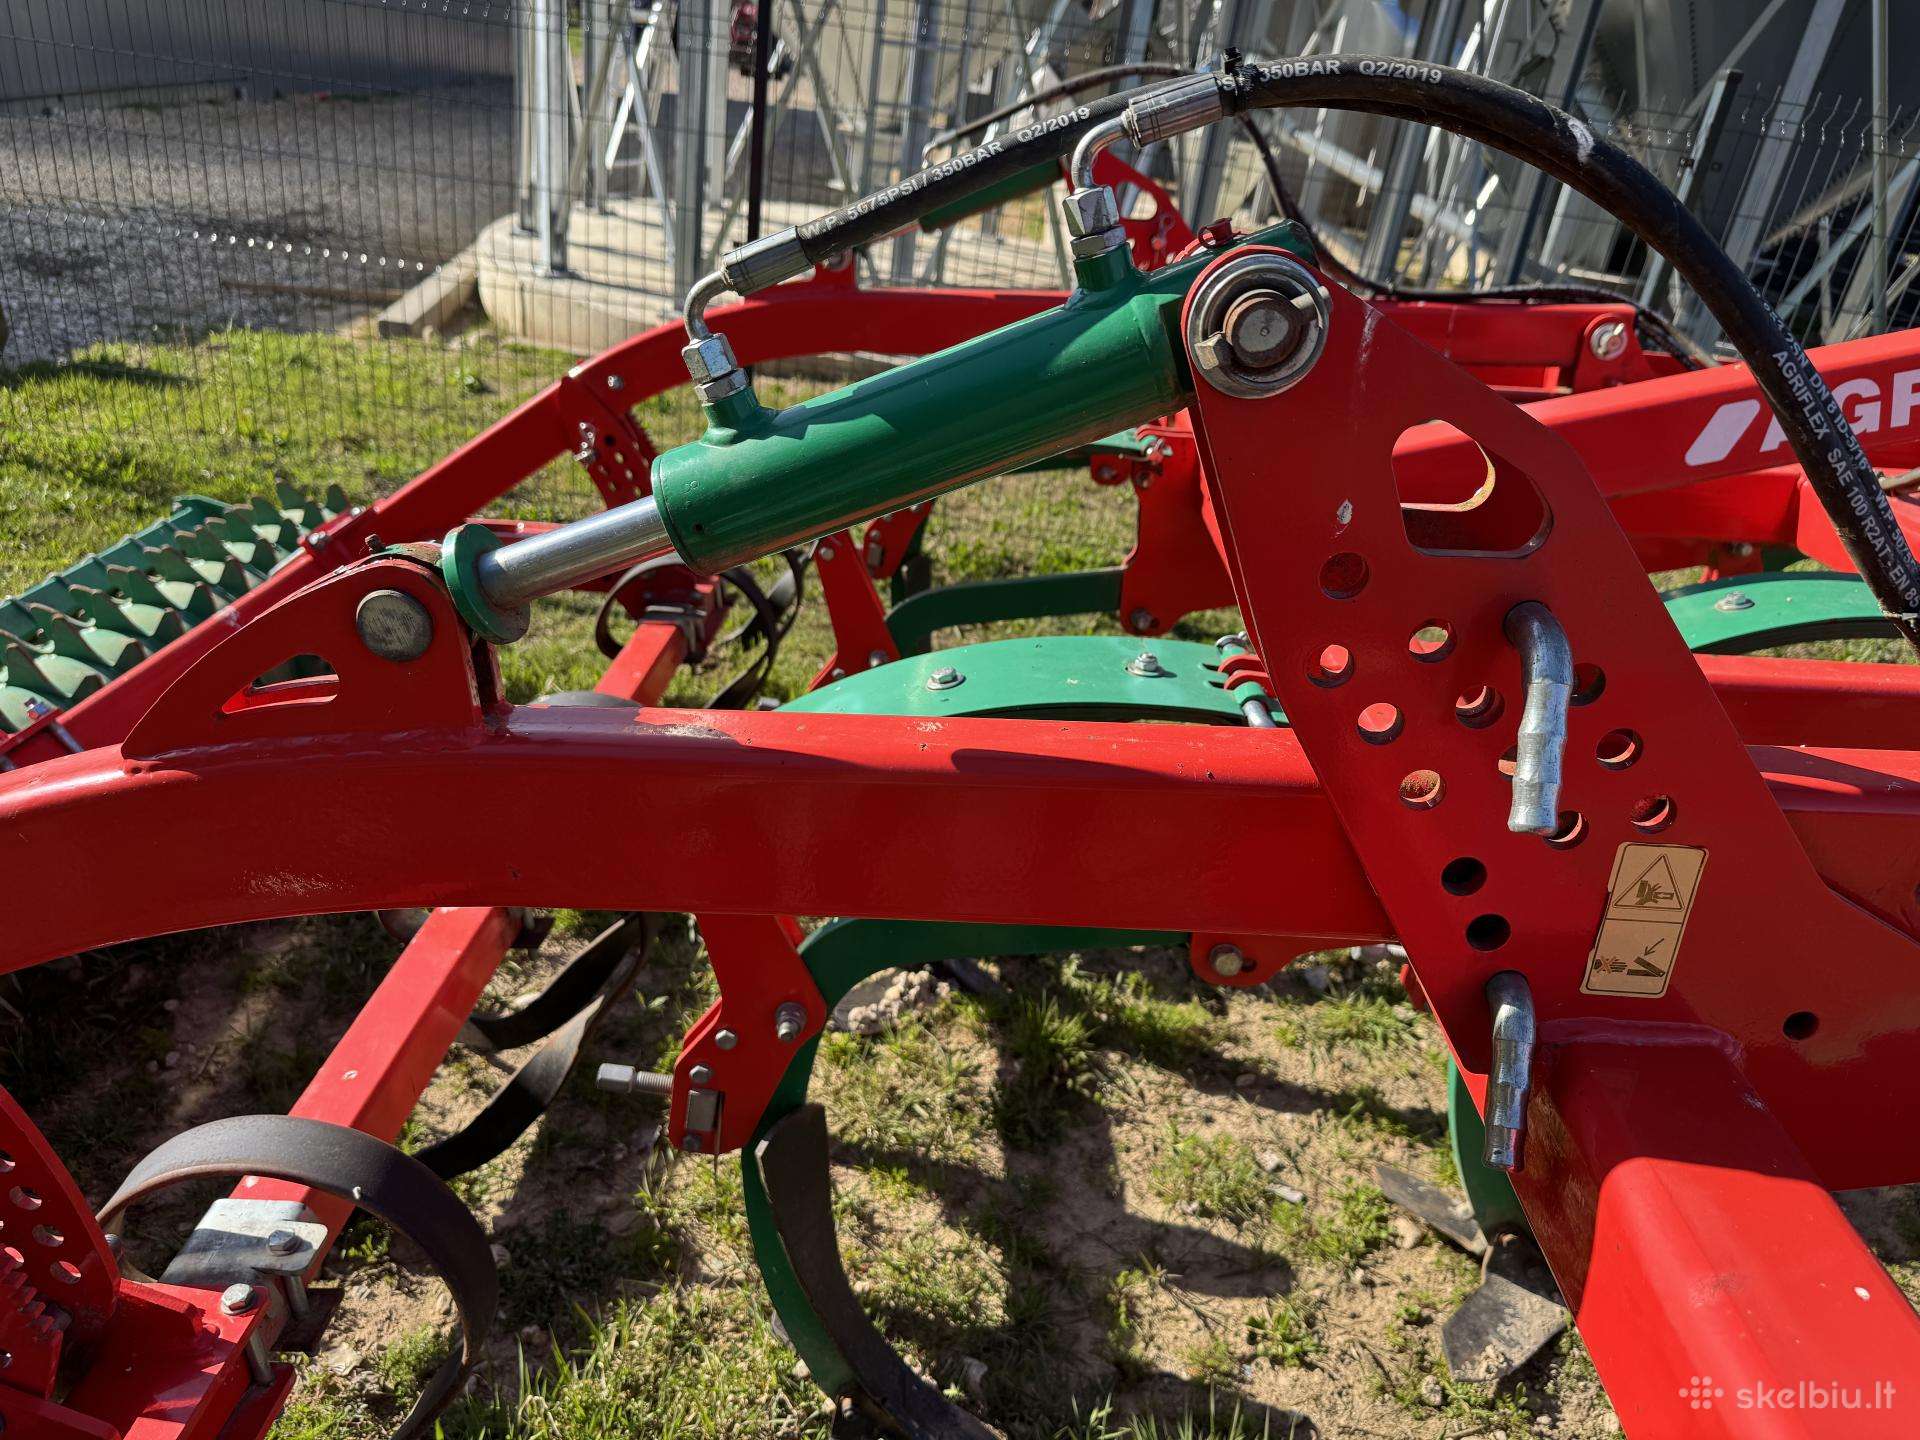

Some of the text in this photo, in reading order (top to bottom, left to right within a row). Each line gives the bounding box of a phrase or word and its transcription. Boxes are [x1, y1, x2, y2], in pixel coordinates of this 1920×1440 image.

[1259, 60, 1442, 84] 350BAR Q2/2019
[932, 141, 1005, 181] 350BAR
[1017, 107, 1091, 142] Q2/2019
[1809, 373, 1830, 400] DN
[1772, 350, 1831, 441] AGRIFLEX
[1827, 447, 1854, 487] SAE
[1846, 486, 1869, 517] 100
[1860, 514, 1892, 558] R2AT
[1889, 565, 1910, 591] EN
